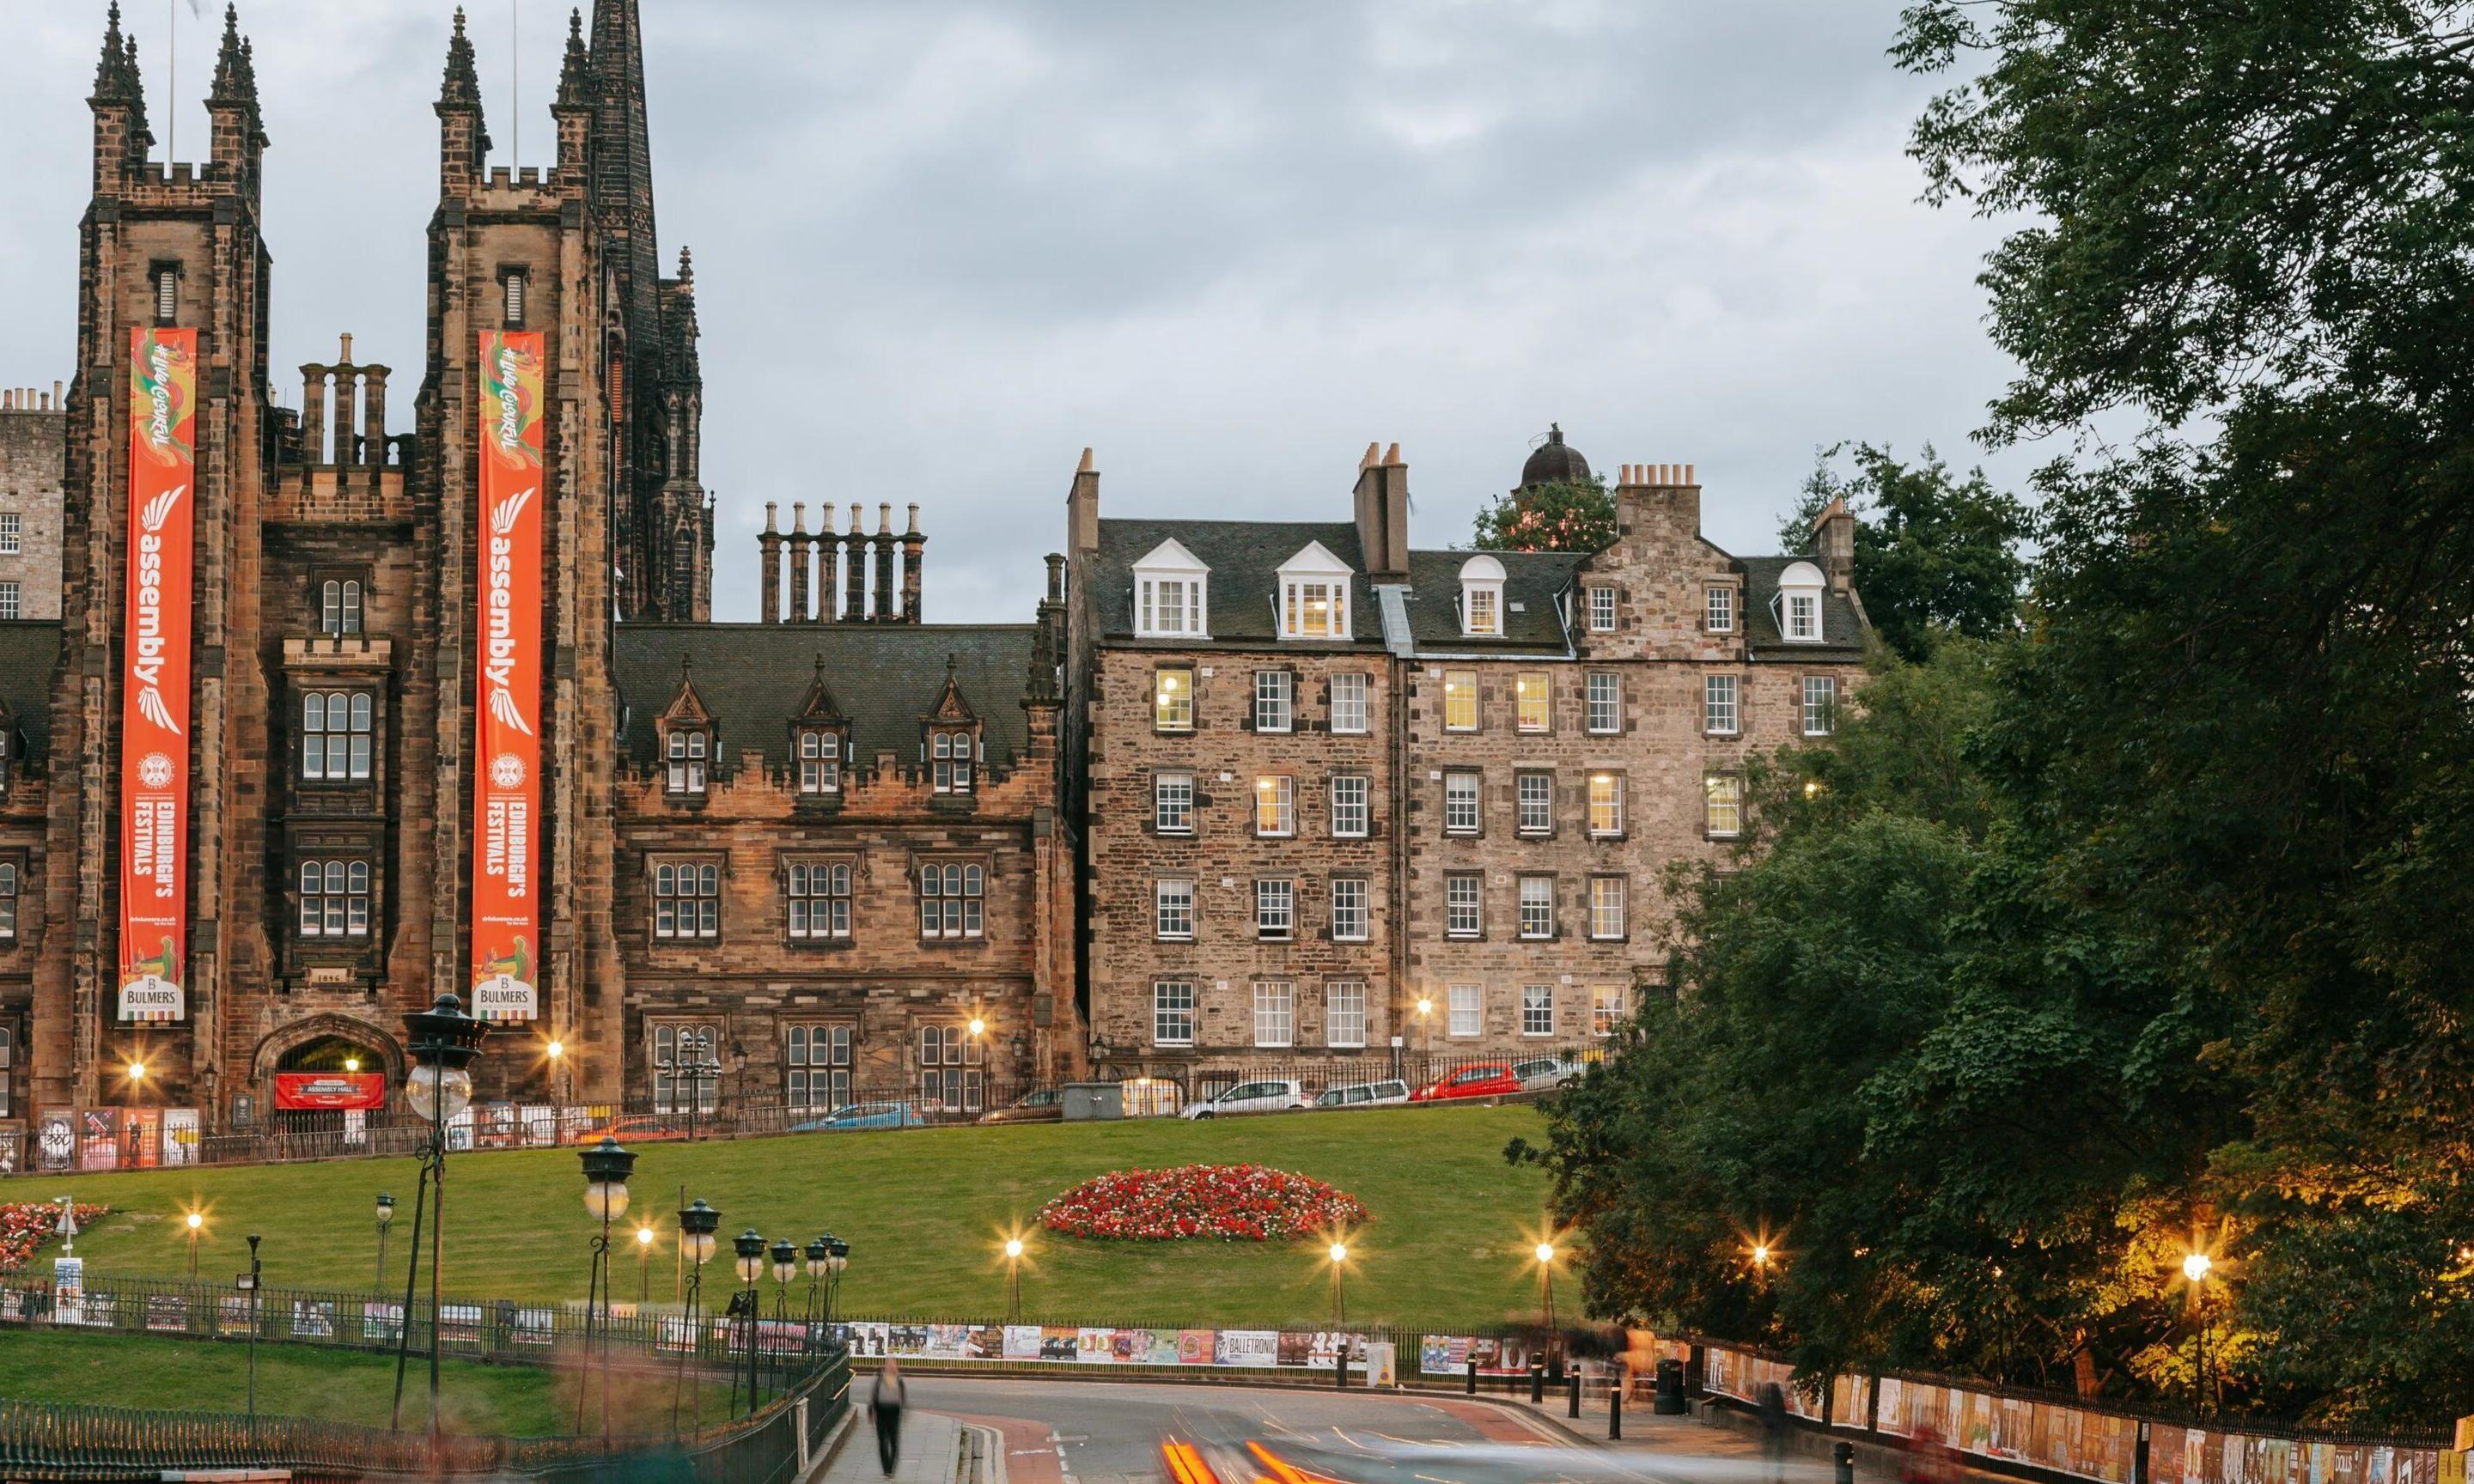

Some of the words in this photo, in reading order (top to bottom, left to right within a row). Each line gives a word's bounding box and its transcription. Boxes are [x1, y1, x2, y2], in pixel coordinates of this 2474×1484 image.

[133, 534, 165, 685] assembly
[485, 537, 515, 687] assembly
[134, 801, 153, 876] FESTIVALS
[155, 801, 175, 897] EDINBURGH'S
[486, 802, 505, 876] FESTIVALS
[508, 802, 527, 897] EDINBURGH'S
[127, 991, 175, 1003] BULMERS
[480, 990, 528, 1002] BULMERS
[1229, 1338, 1276, 1353] BALLETRONIC
[2335, 1455, 2353, 1473] DOLLS
